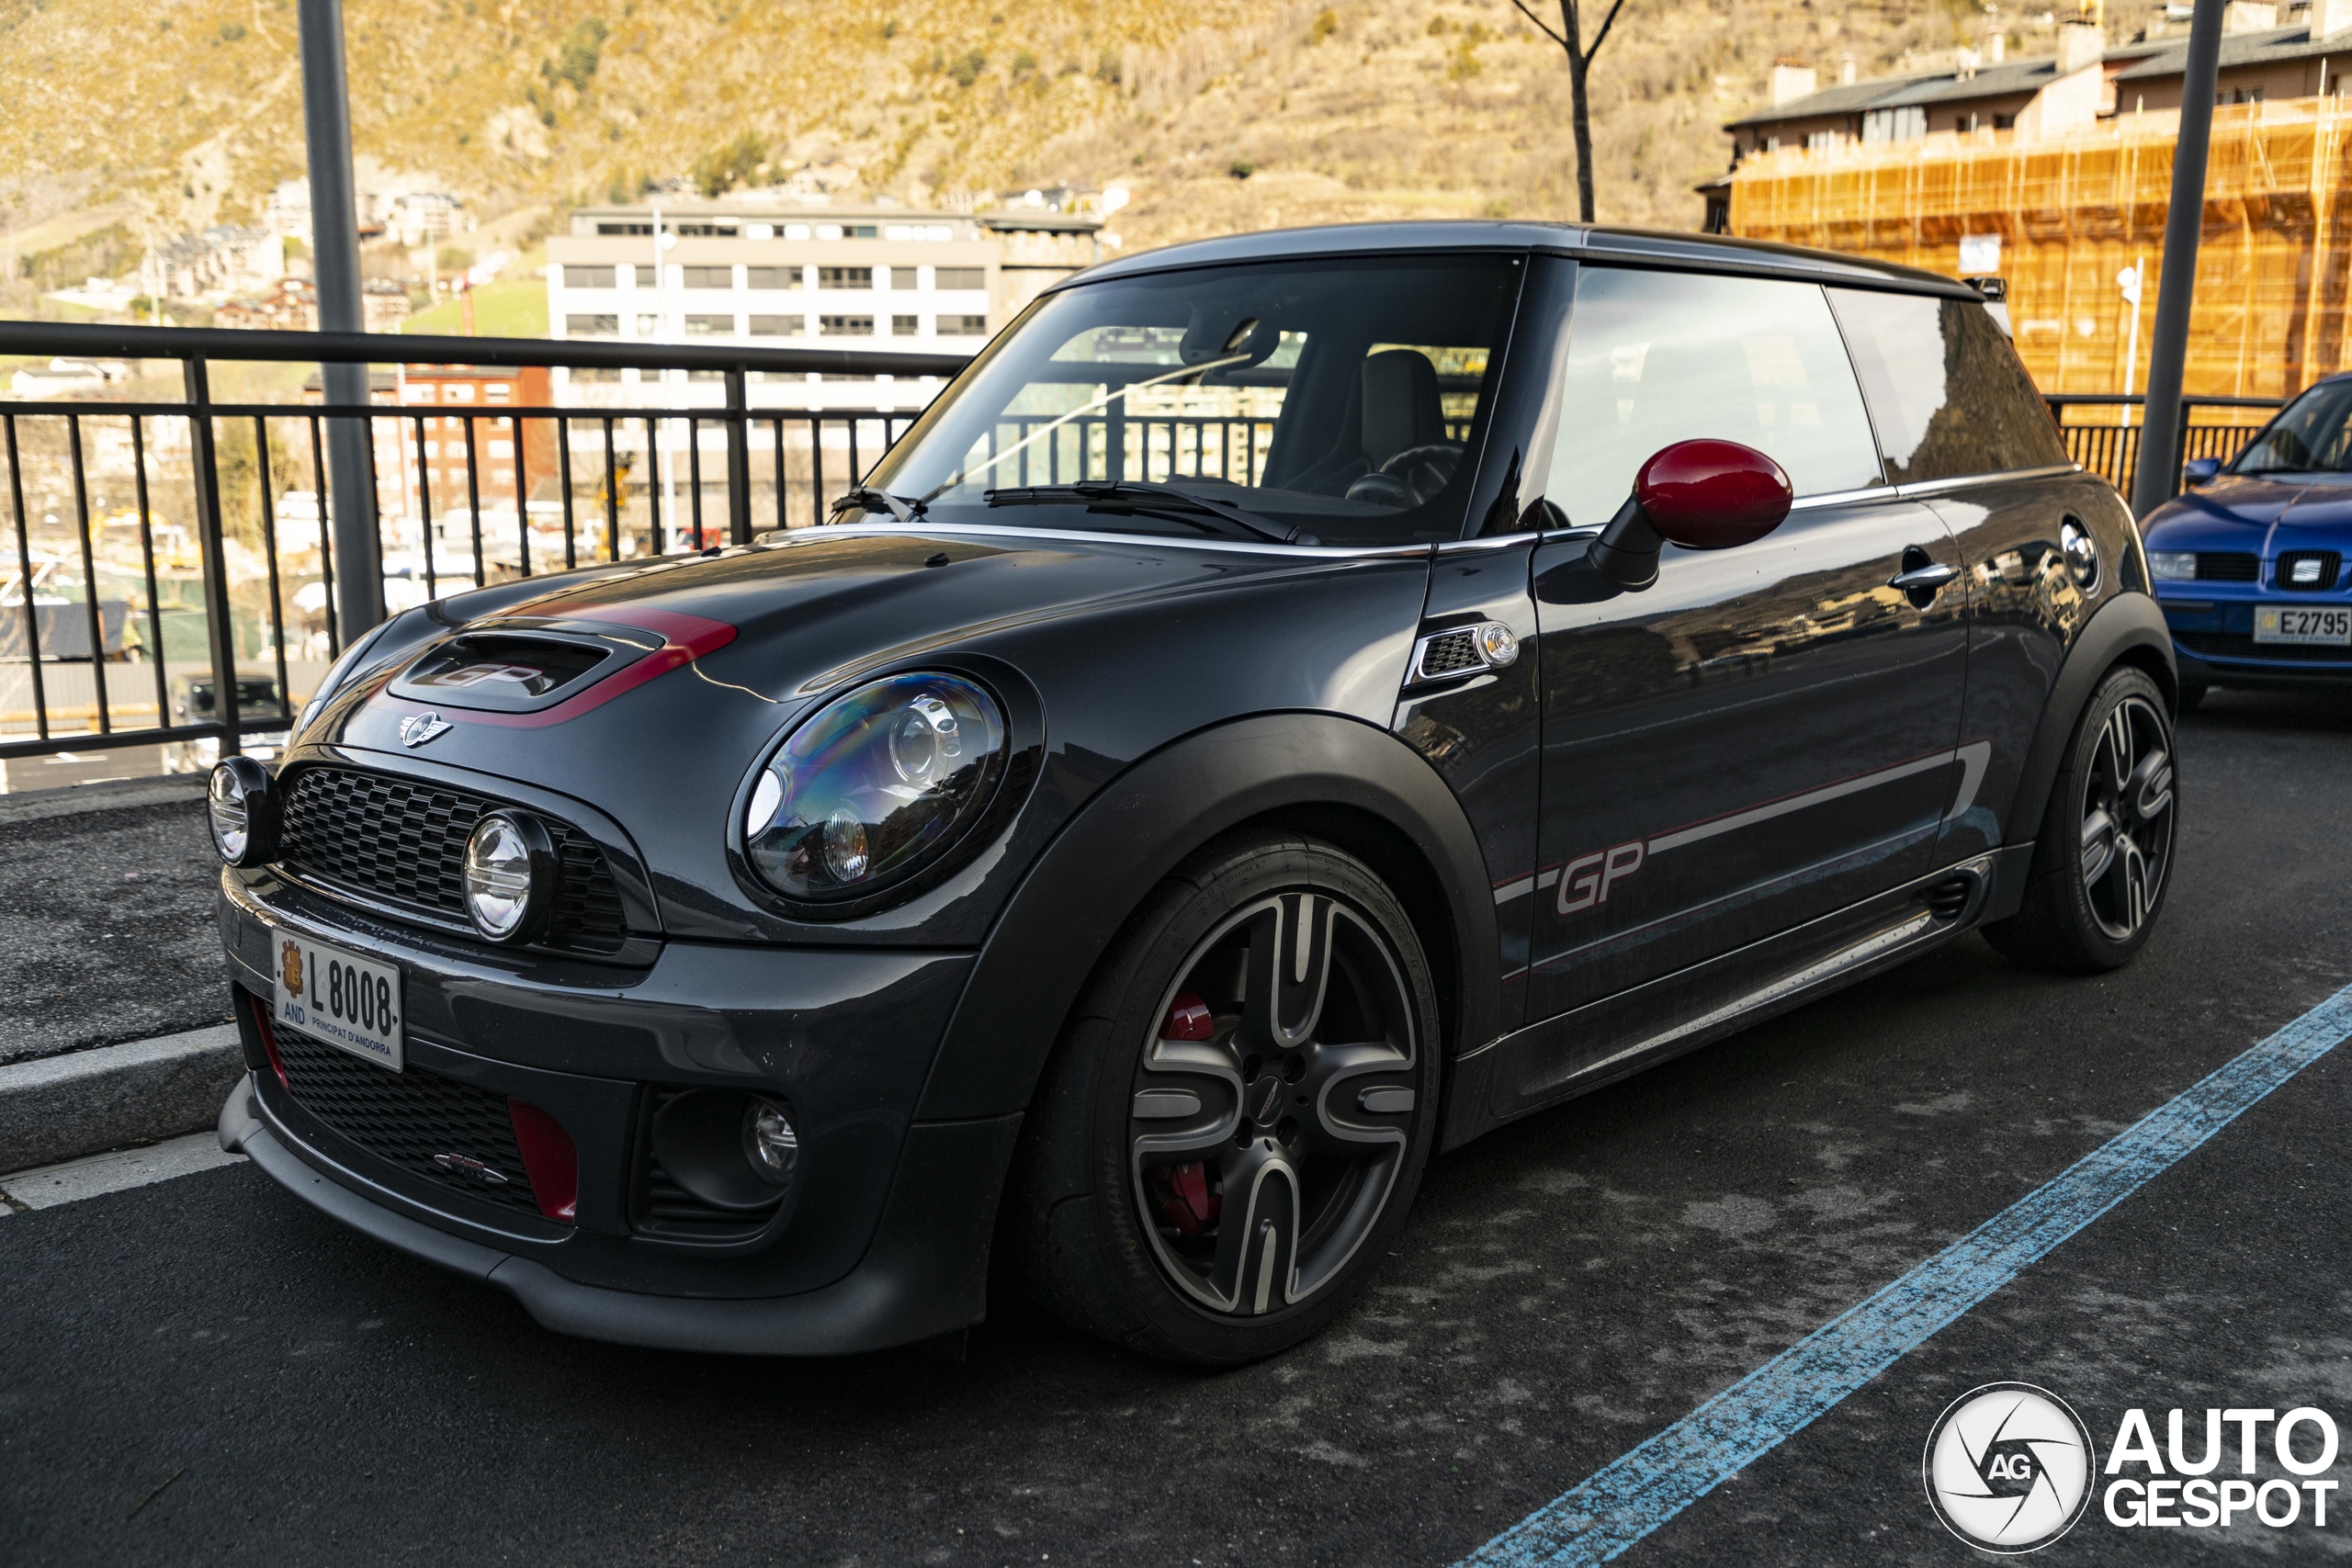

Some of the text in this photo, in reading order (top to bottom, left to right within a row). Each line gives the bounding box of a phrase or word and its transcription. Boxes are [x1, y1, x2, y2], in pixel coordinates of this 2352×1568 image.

[2280, 611, 2348, 636] E2795
[432, 662, 545, 687] GP
[1557, 839, 1645, 915] GP
[284, 1001, 305, 1025] AND
[329, 960, 391, 1036] 8008
[311, 1016, 391, 1057] PRINCIPAT D'ANDORRA
